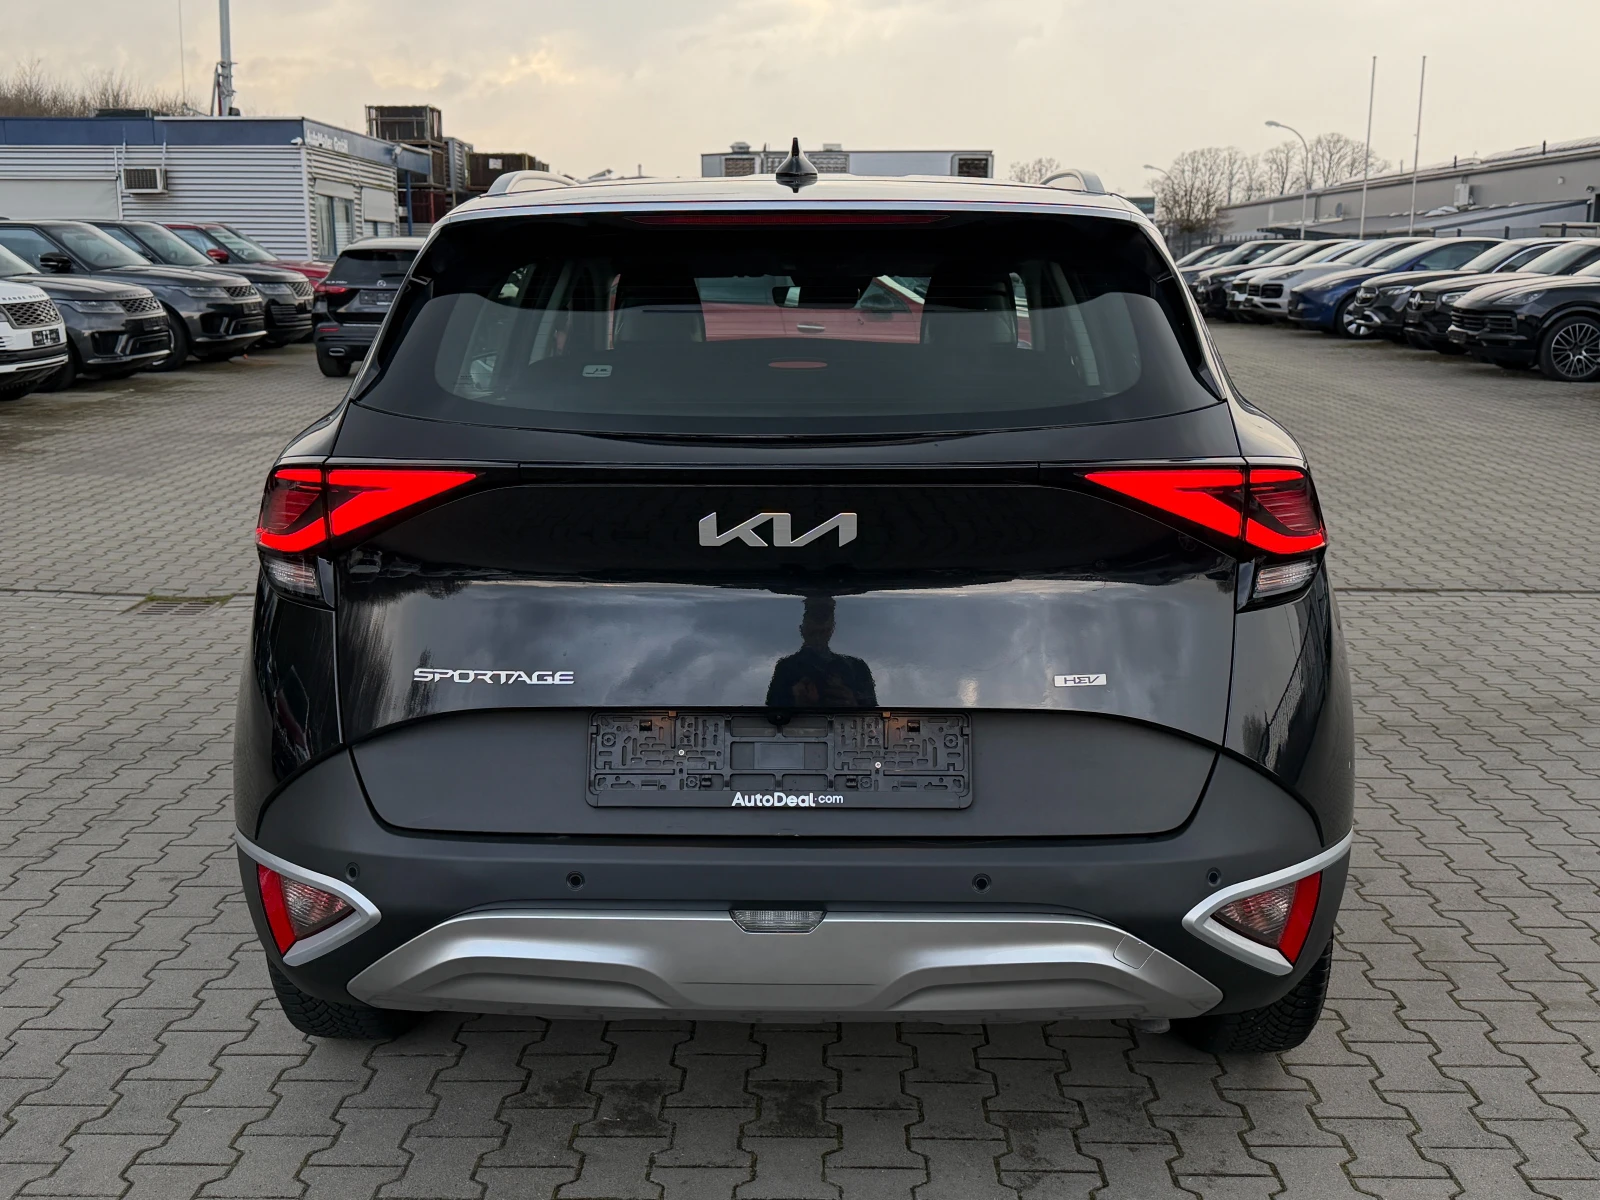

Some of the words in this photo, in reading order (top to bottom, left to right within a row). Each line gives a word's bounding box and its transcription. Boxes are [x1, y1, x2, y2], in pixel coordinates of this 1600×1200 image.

[698, 512, 858, 548] KIA
[413, 667, 575, 685] SPORTAGE
[1063, 675, 1101, 685] HEV
